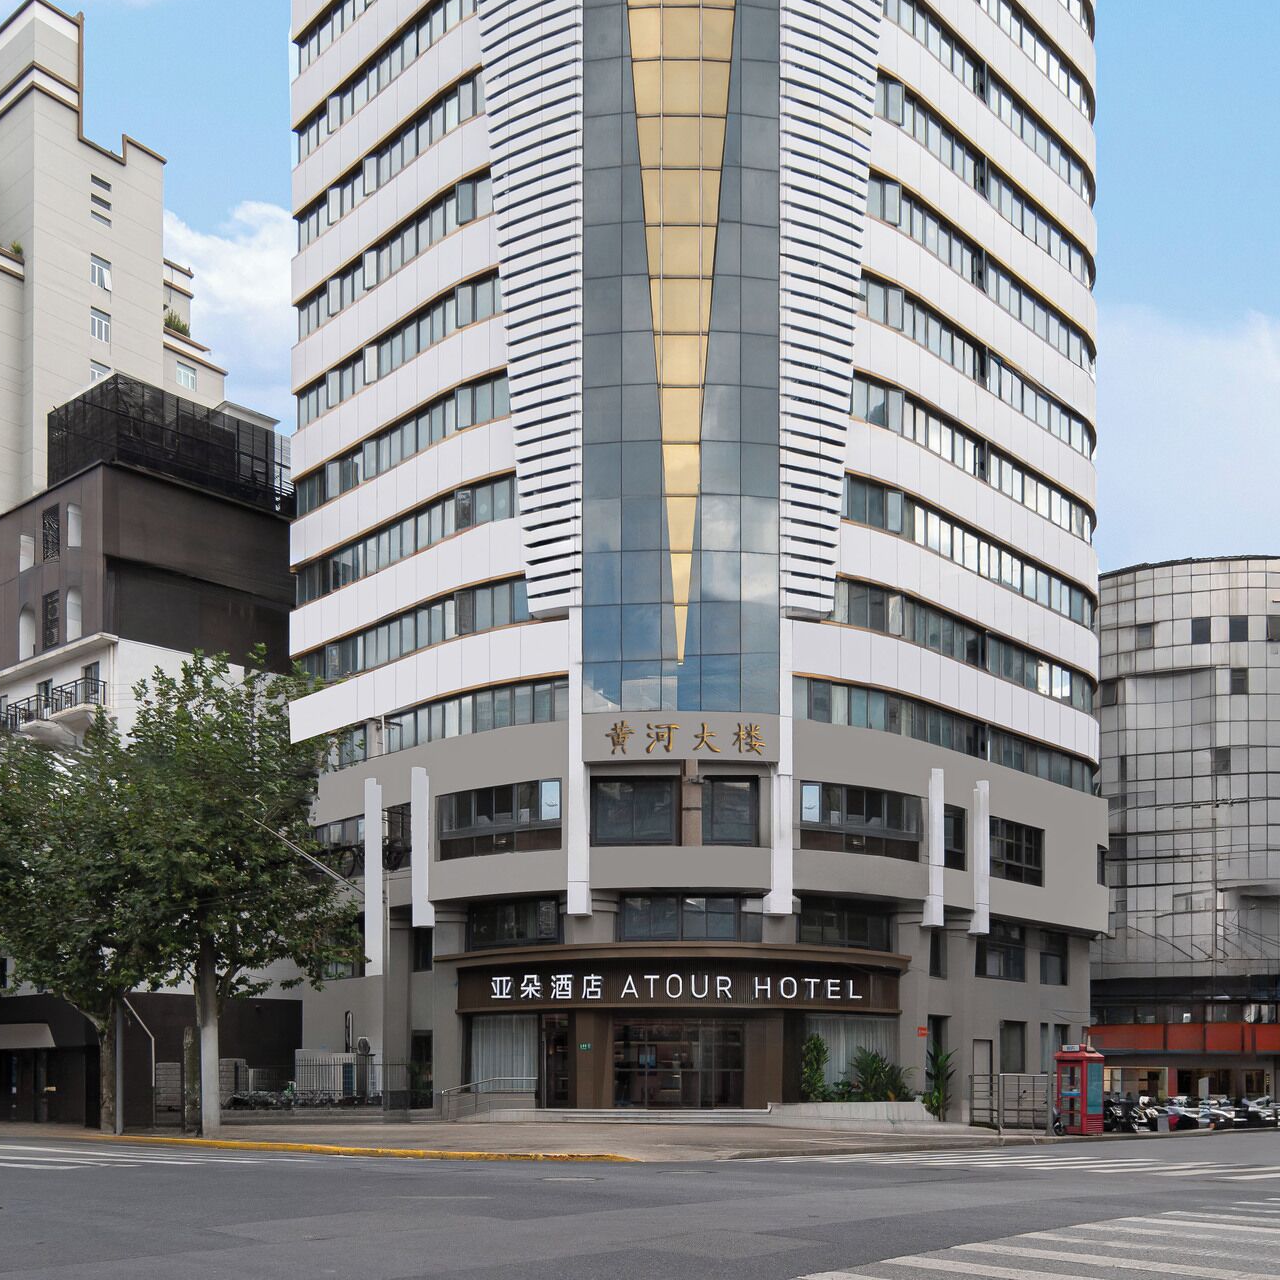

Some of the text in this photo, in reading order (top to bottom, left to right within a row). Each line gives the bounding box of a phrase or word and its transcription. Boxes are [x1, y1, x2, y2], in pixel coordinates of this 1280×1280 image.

[605, 720, 767, 755] 黄河大楼
[490, 973, 863, 999] 亚朵酒店 ATOUR HOTEL
